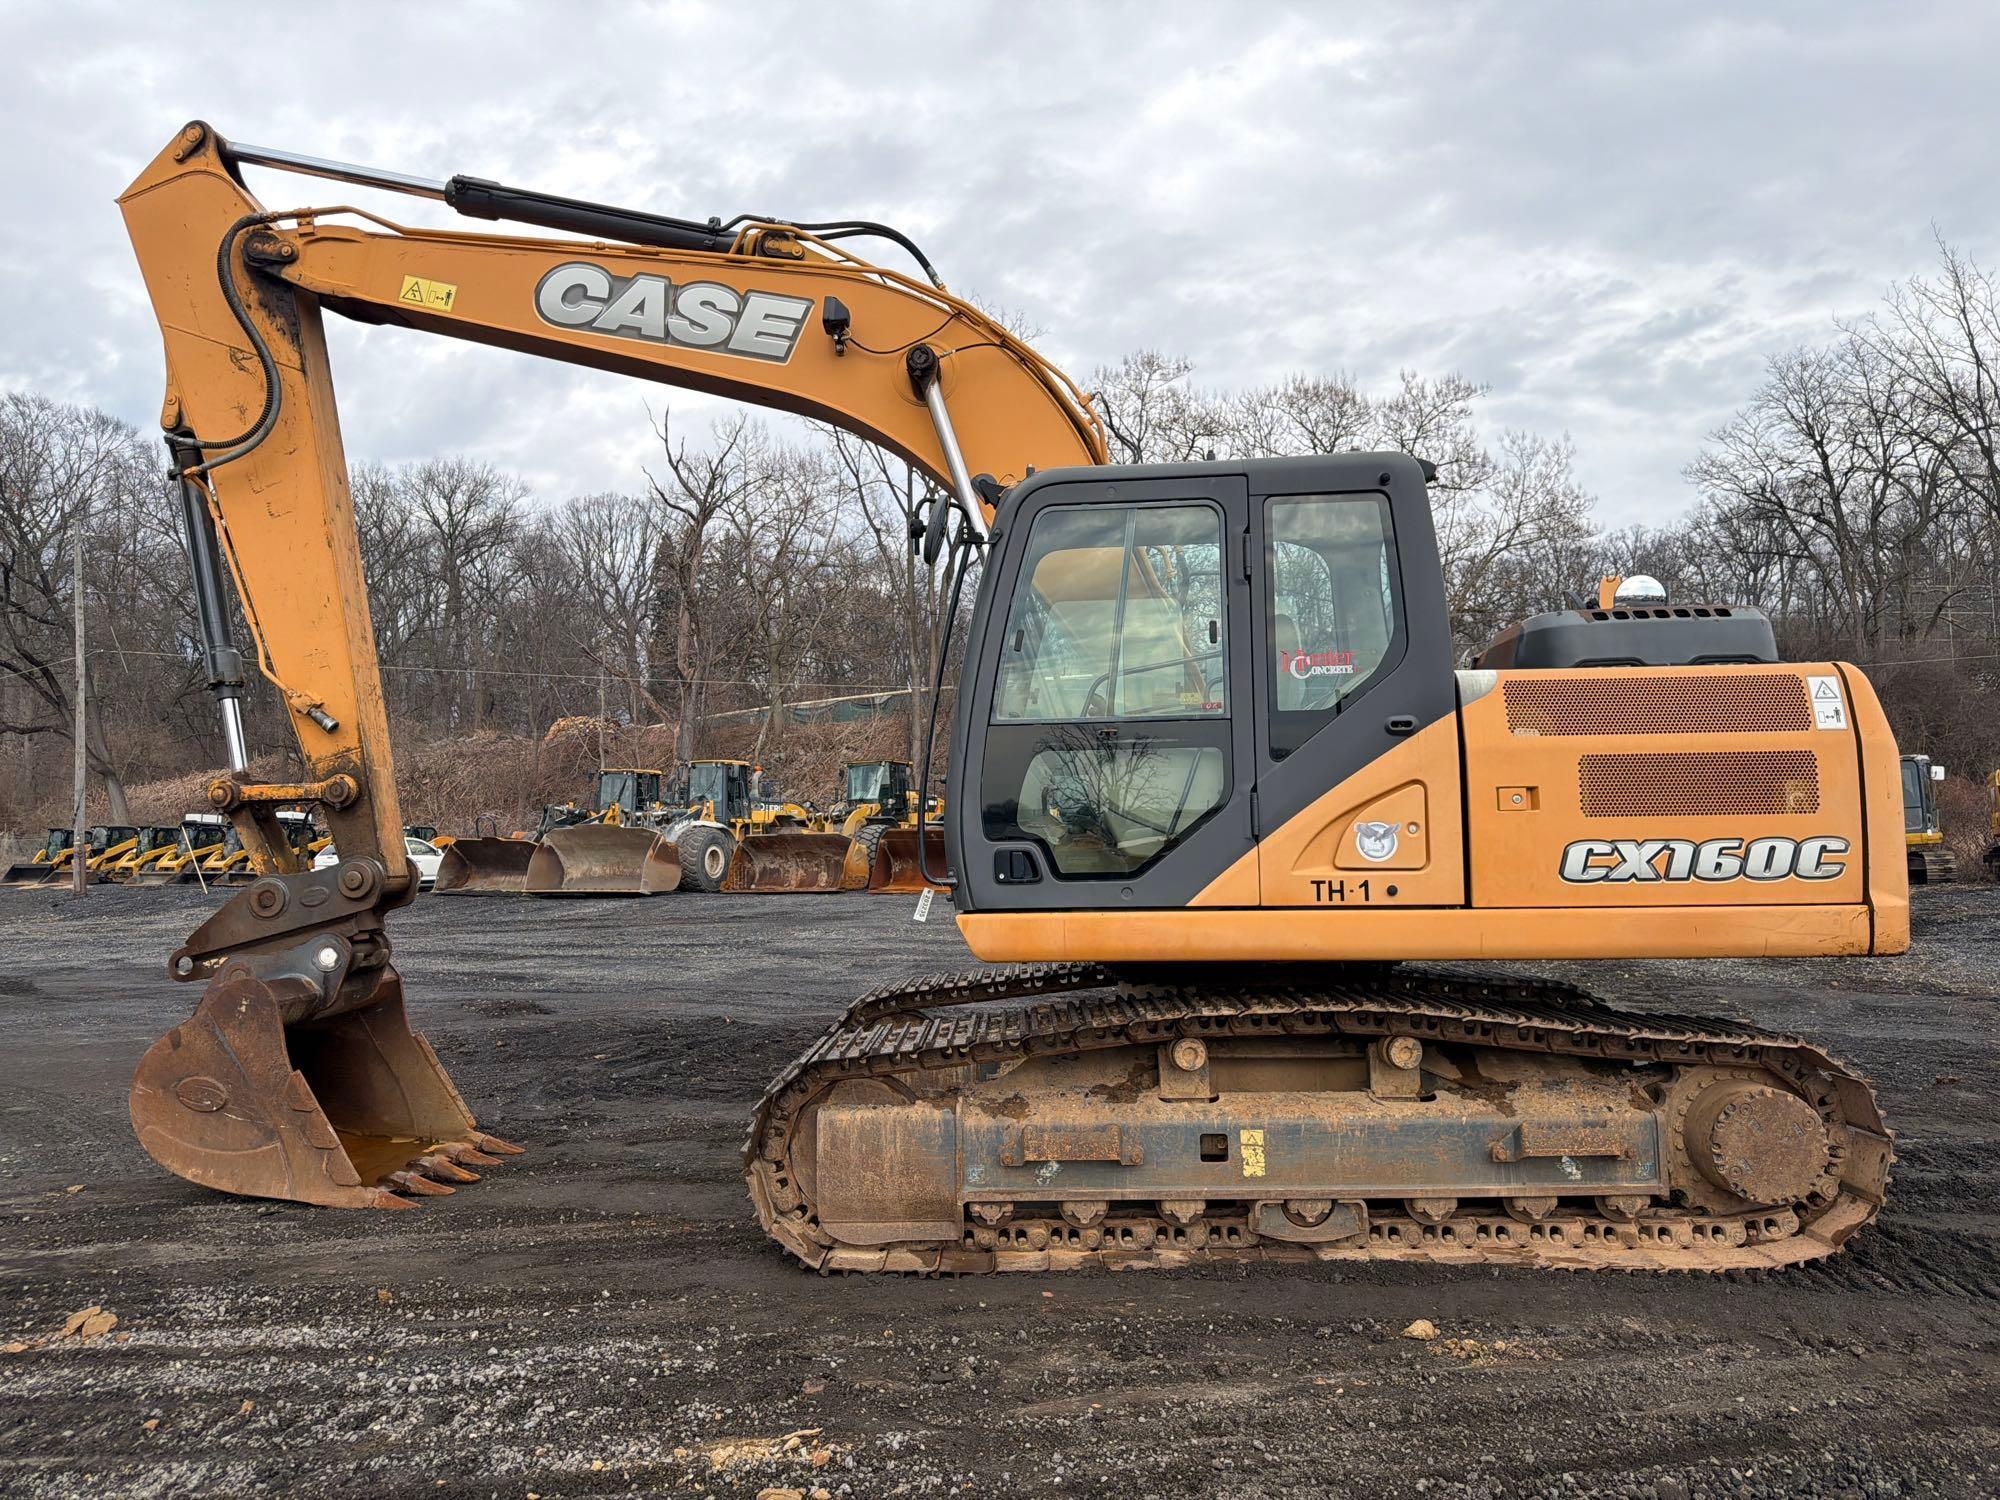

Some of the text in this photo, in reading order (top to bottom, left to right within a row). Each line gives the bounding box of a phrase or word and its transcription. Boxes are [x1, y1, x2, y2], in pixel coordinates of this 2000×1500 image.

[537, 264, 811, 359] CASE
[1561, 837, 1850, 881] CX160C
[1310, 879, 1370, 902] TH-1
